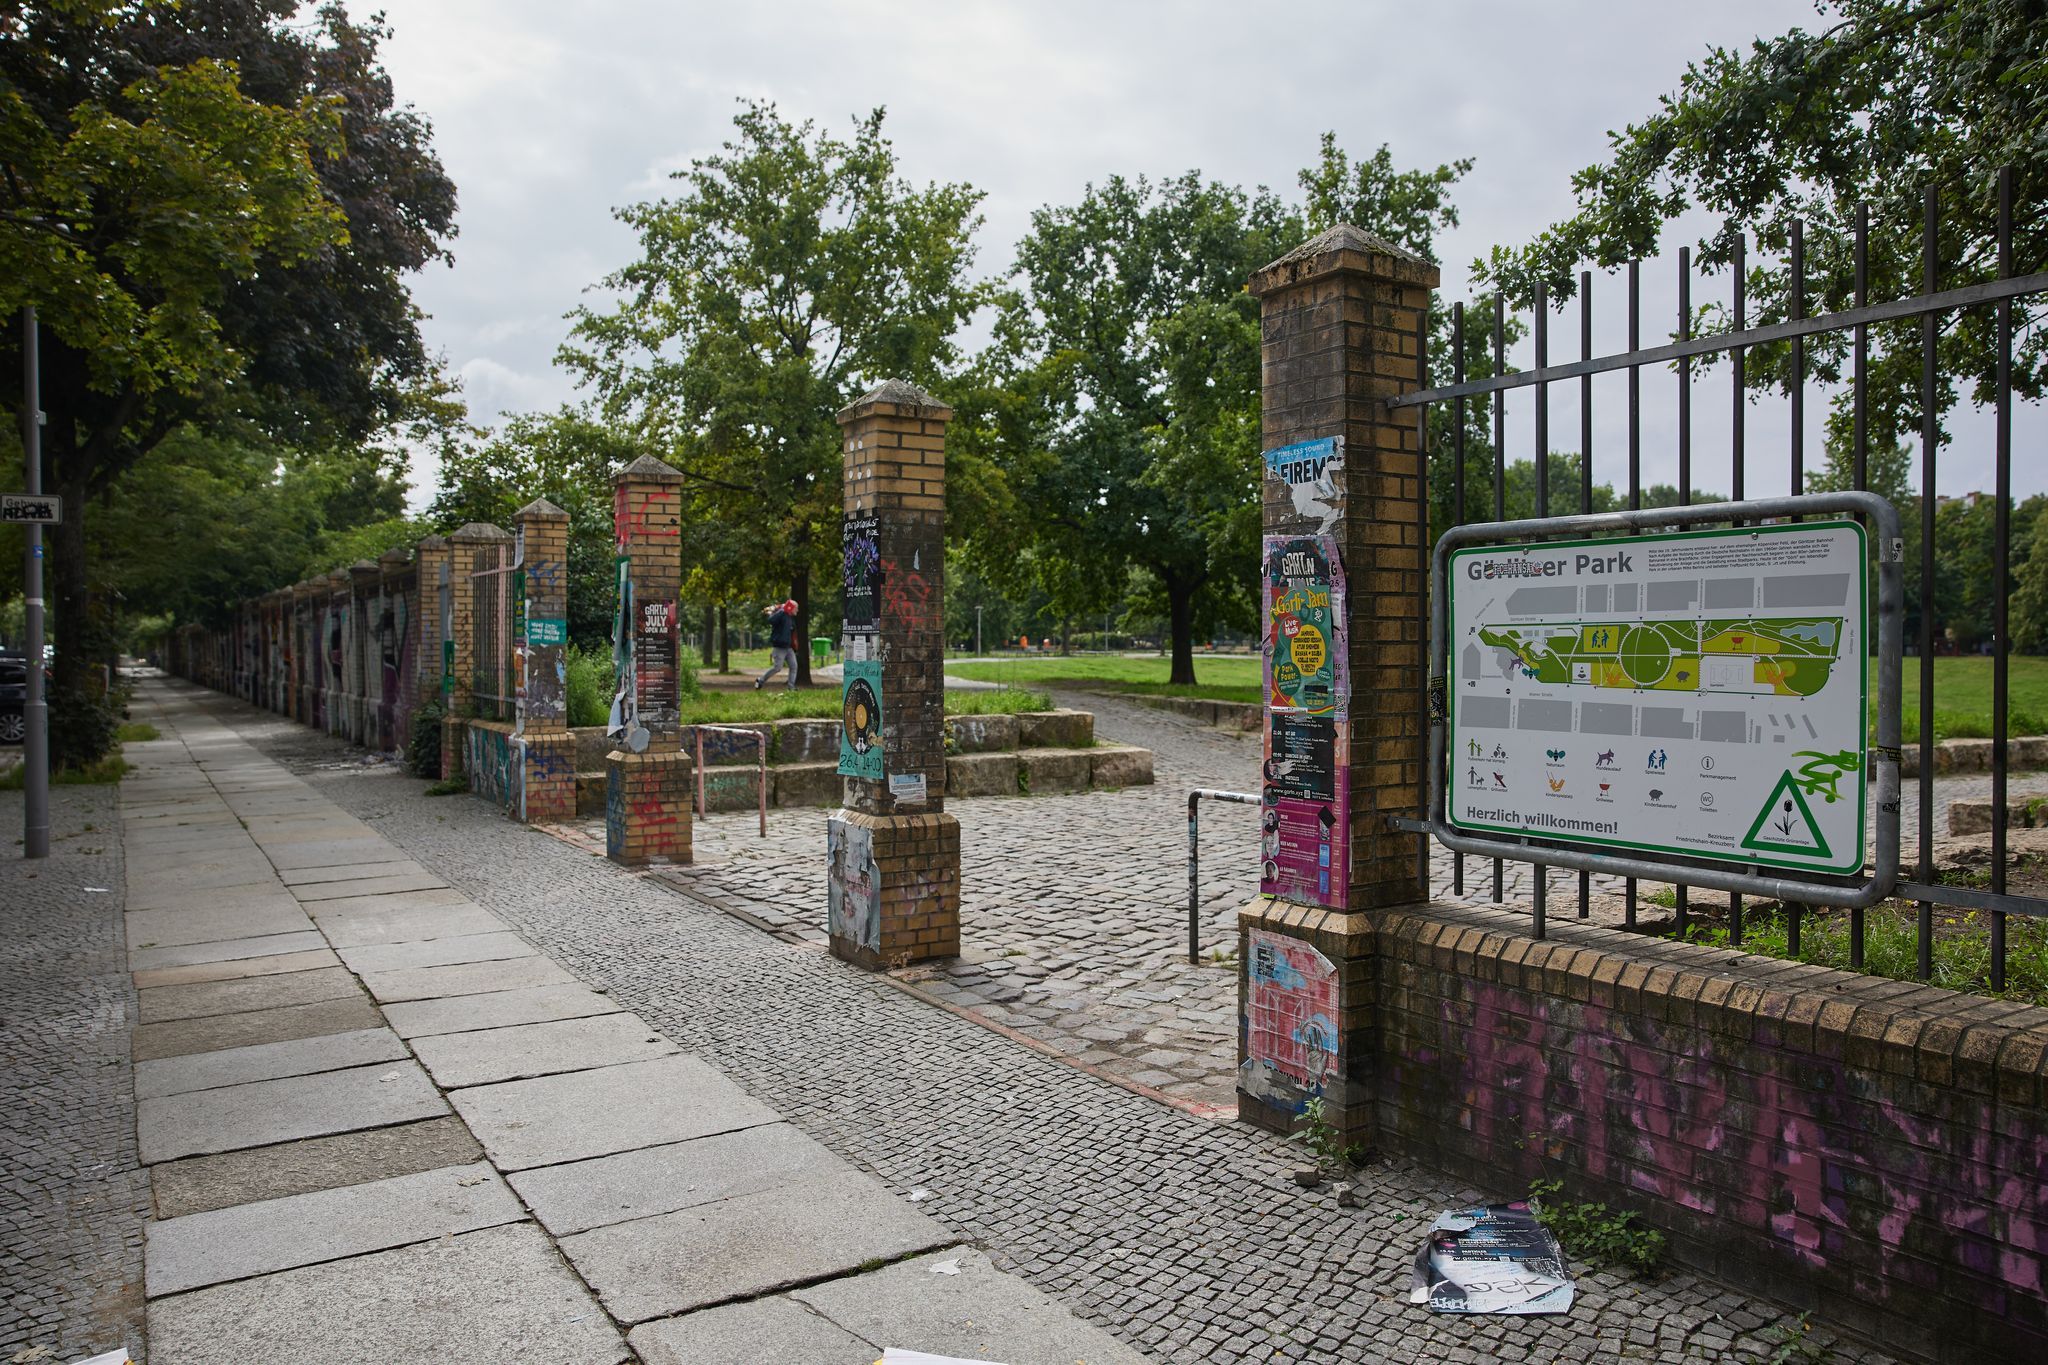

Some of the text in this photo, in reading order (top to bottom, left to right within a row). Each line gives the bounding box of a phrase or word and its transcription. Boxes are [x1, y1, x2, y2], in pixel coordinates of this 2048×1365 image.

[1576, 552, 1632, 574] Park
[646, 616, 667, 627] JULY
[1467, 806, 1618, 834] Herzlich willkommen!
[1676, 836, 1735, 848] Friedrichshain-Kreuzberg
